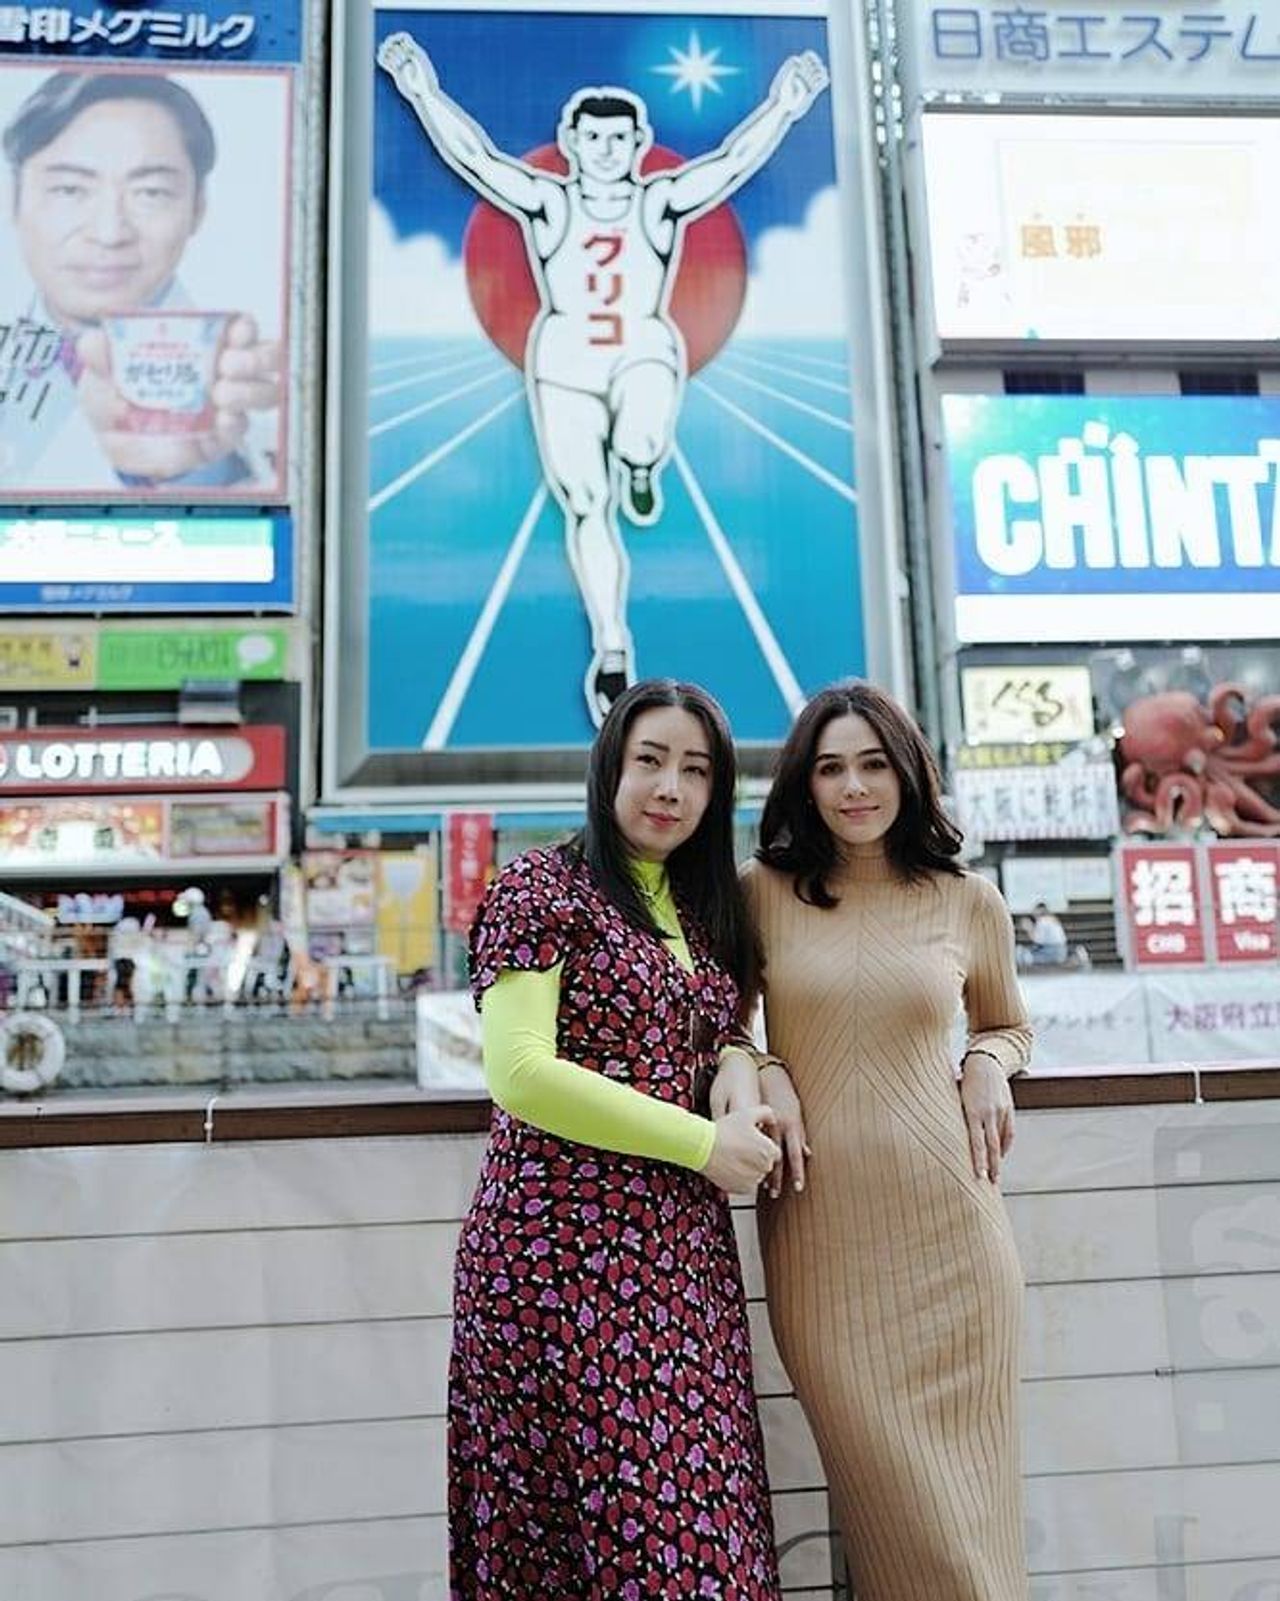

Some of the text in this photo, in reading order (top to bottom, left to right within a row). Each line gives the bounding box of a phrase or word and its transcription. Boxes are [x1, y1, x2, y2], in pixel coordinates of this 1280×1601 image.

[584, 228, 627, 346] グリコ
[16, 740, 223, 779] LOTTERIA
